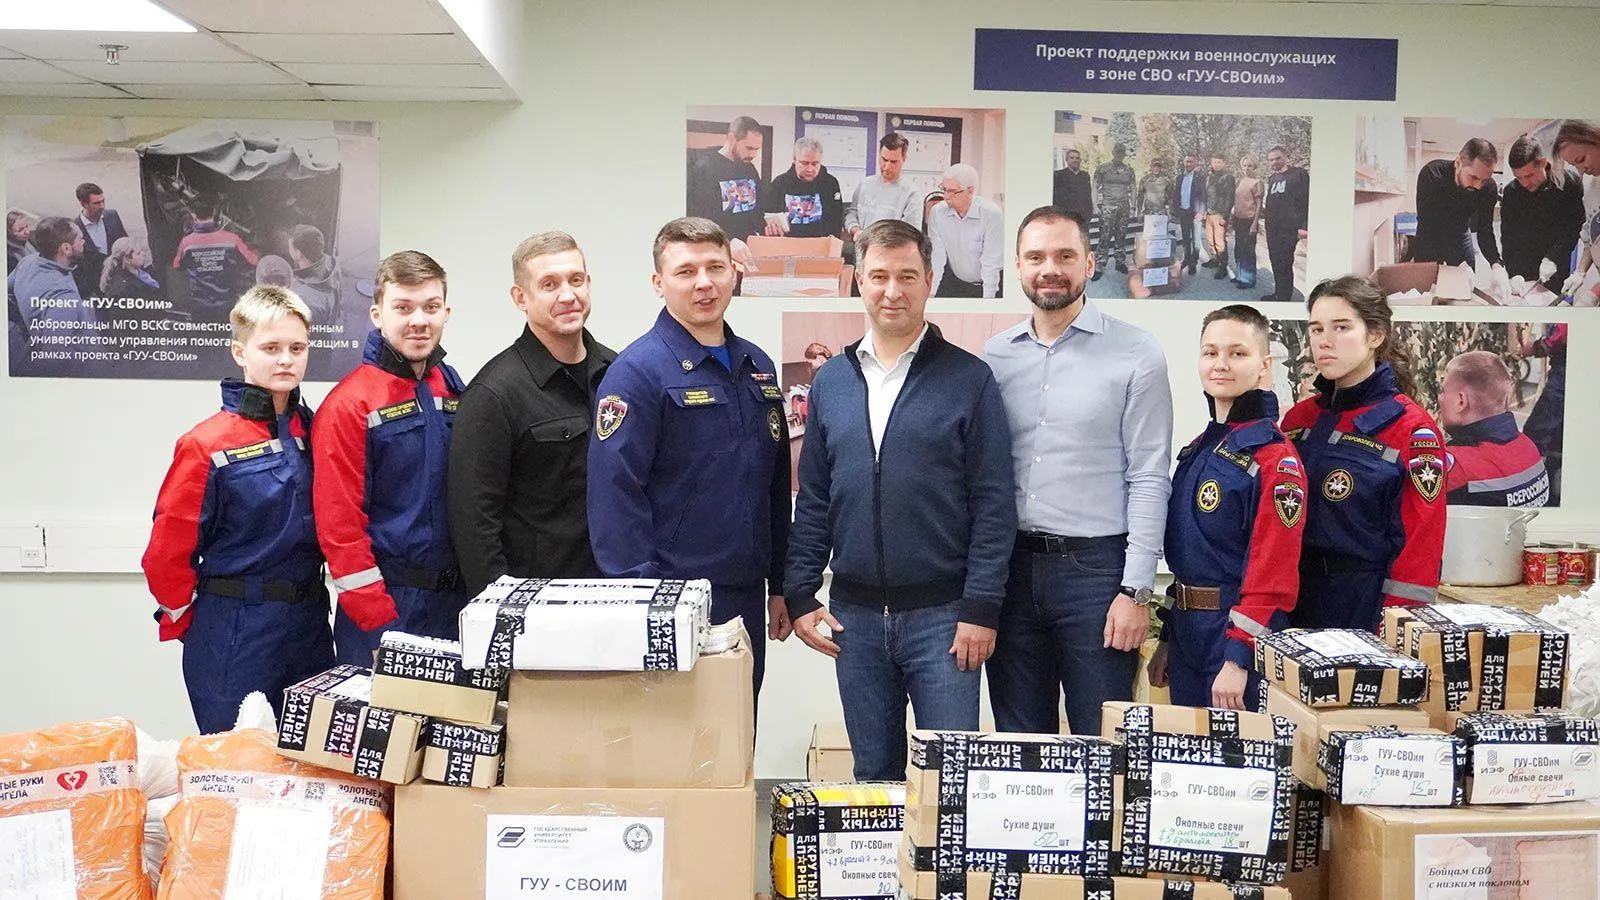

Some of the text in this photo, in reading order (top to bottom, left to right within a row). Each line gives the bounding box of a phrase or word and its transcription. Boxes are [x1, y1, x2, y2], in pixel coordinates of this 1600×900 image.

[1036, 44, 1336, 67] Проект поддержки военнослужащих
[1085, 68, 1285, 84] в зоне СВО «ГУУ-СВОим»
[30, 296, 173, 310] Проект «ГУУ-СВОим»
[30, 319, 232, 333] Добровольцы МГО ВСКС совместно
[30, 335, 233, 348] университетом управления помога
[31, 350, 198, 362] рамках проекта «ГУУ-СВОим»
[395, 651, 457, 671] КРУТЫХ
[443, 725, 499, 745] КРУТЫХ
[190, 775, 229, 784] ЗОЛОТЫЕ
[1088, 744, 1101, 810] КРУТЫХ
[1374, 764, 1425, 781] Сухие души
[1538, 774, 1563, 782] свечи
[20, 776, 44, 789] РУКИ
[338, 784, 378, 796] ЗОЛОТЫЕ
[1003, 818, 1055, 834] Сухие души
[1175, 816, 1244, 835] Окопные свечи
[842, 869, 876, 880] Окопные
[1428, 866, 1492, 878] Бойцам СВО
[520, 876, 550, 891] ГУУ
[565, 878, 627, 892] СВОИМ
[1428, 879, 1531, 890] с низким поклоном
